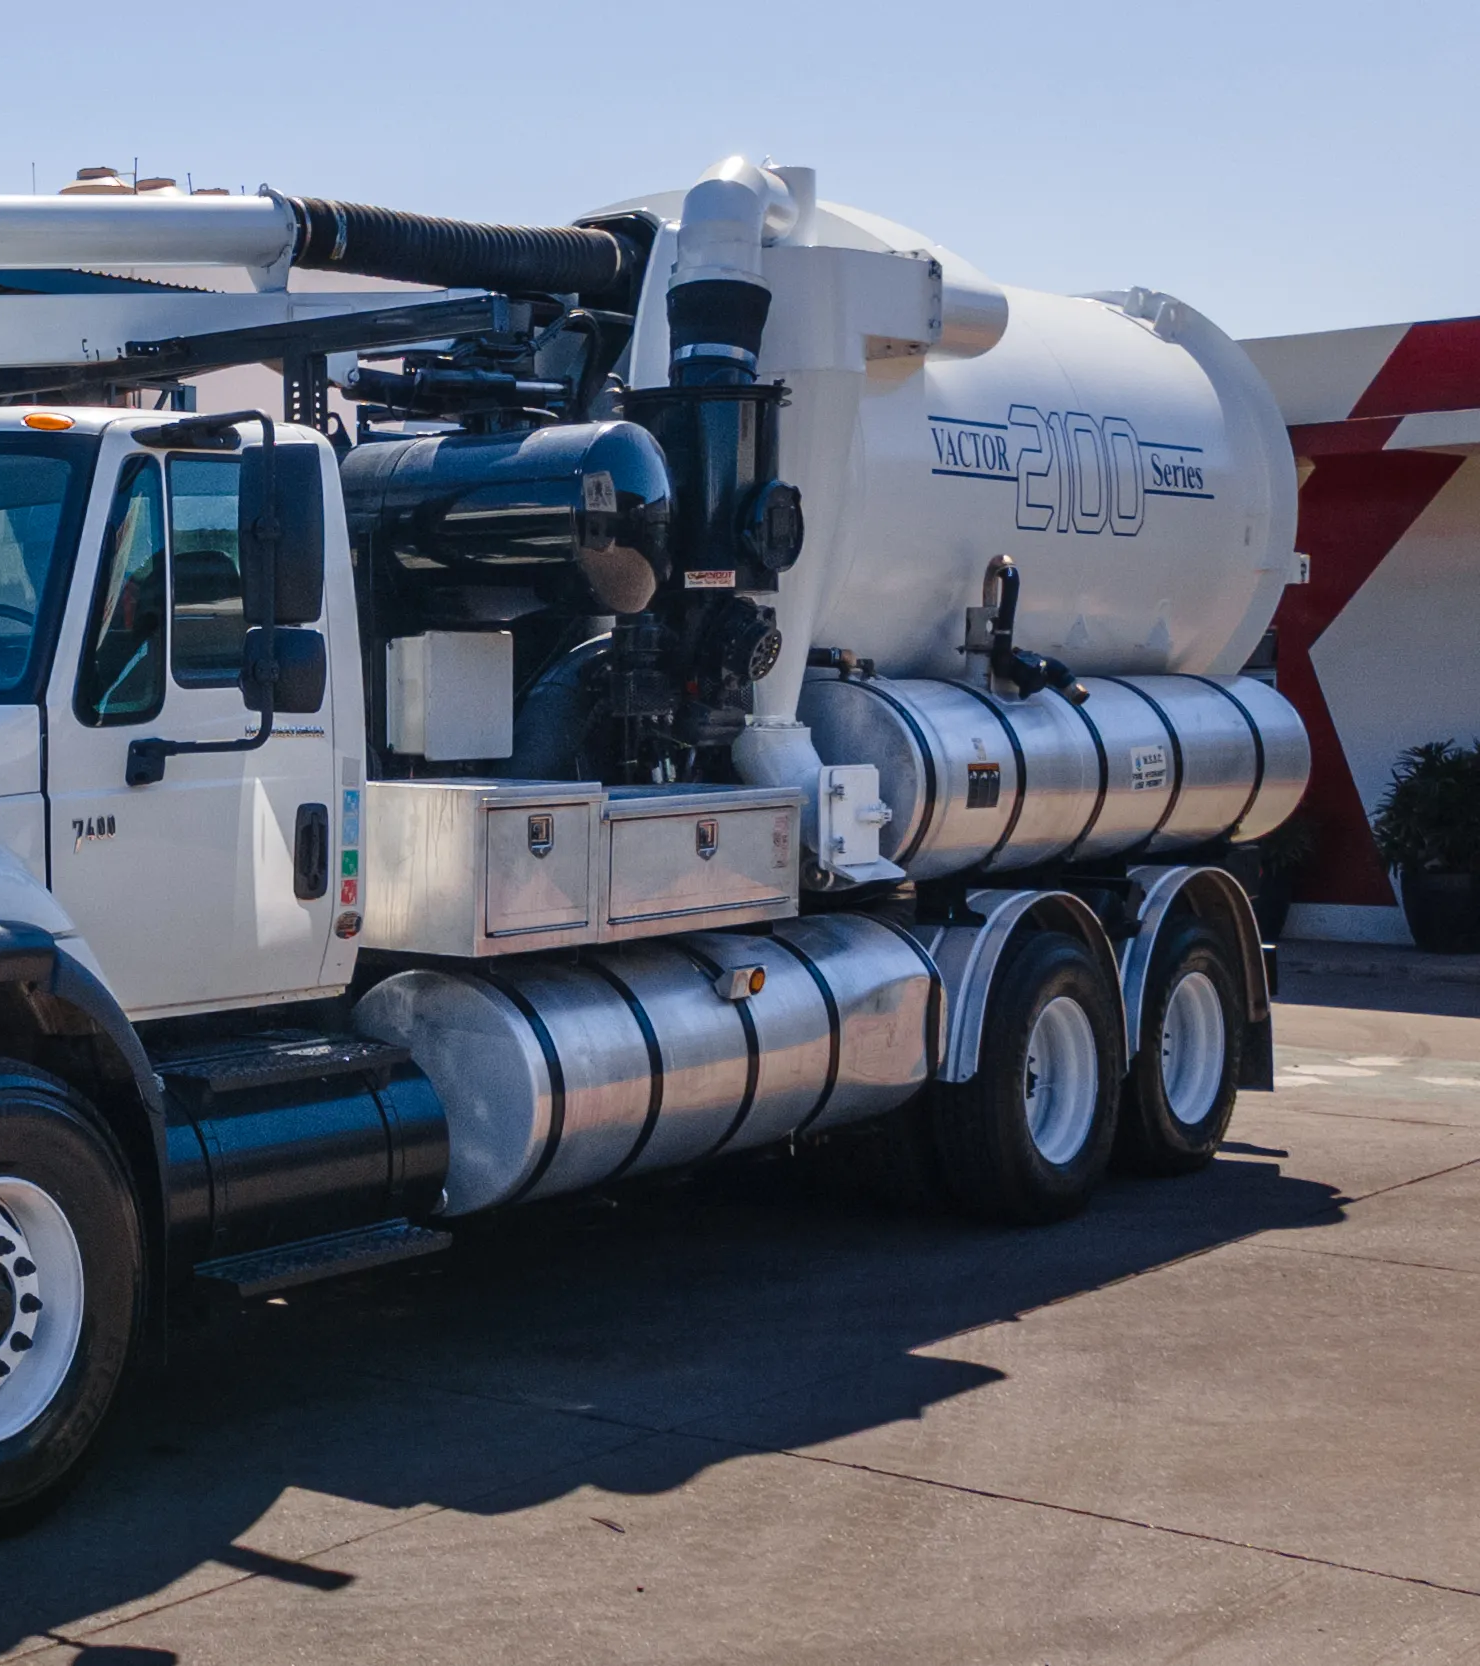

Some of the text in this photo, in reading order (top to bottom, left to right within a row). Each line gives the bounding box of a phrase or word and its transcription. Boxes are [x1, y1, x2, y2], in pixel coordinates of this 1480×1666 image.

[931, 403, 1205, 537] VACTOR 2100 Series
